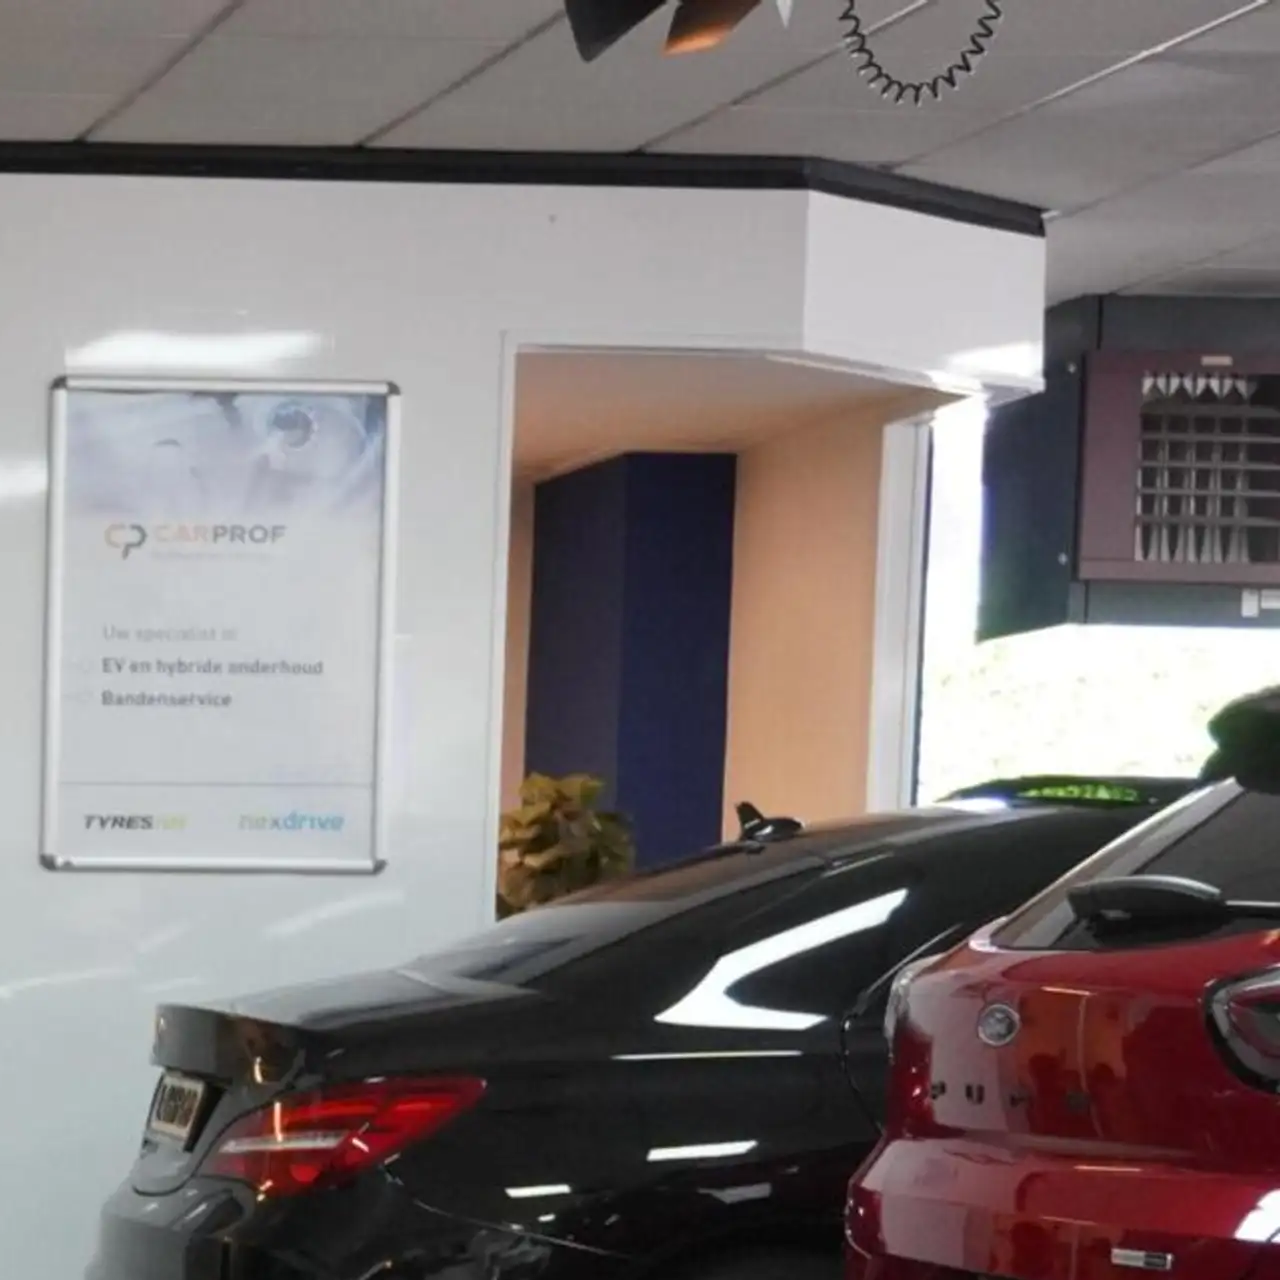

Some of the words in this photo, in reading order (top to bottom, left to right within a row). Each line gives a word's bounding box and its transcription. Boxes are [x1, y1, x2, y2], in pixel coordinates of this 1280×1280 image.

[153, 523, 288, 545] CARPROF
[101, 657, 126, 674] EV
[155, 657, 223, 677] hybride
[101, 689, 233, 707] Bandenservice
